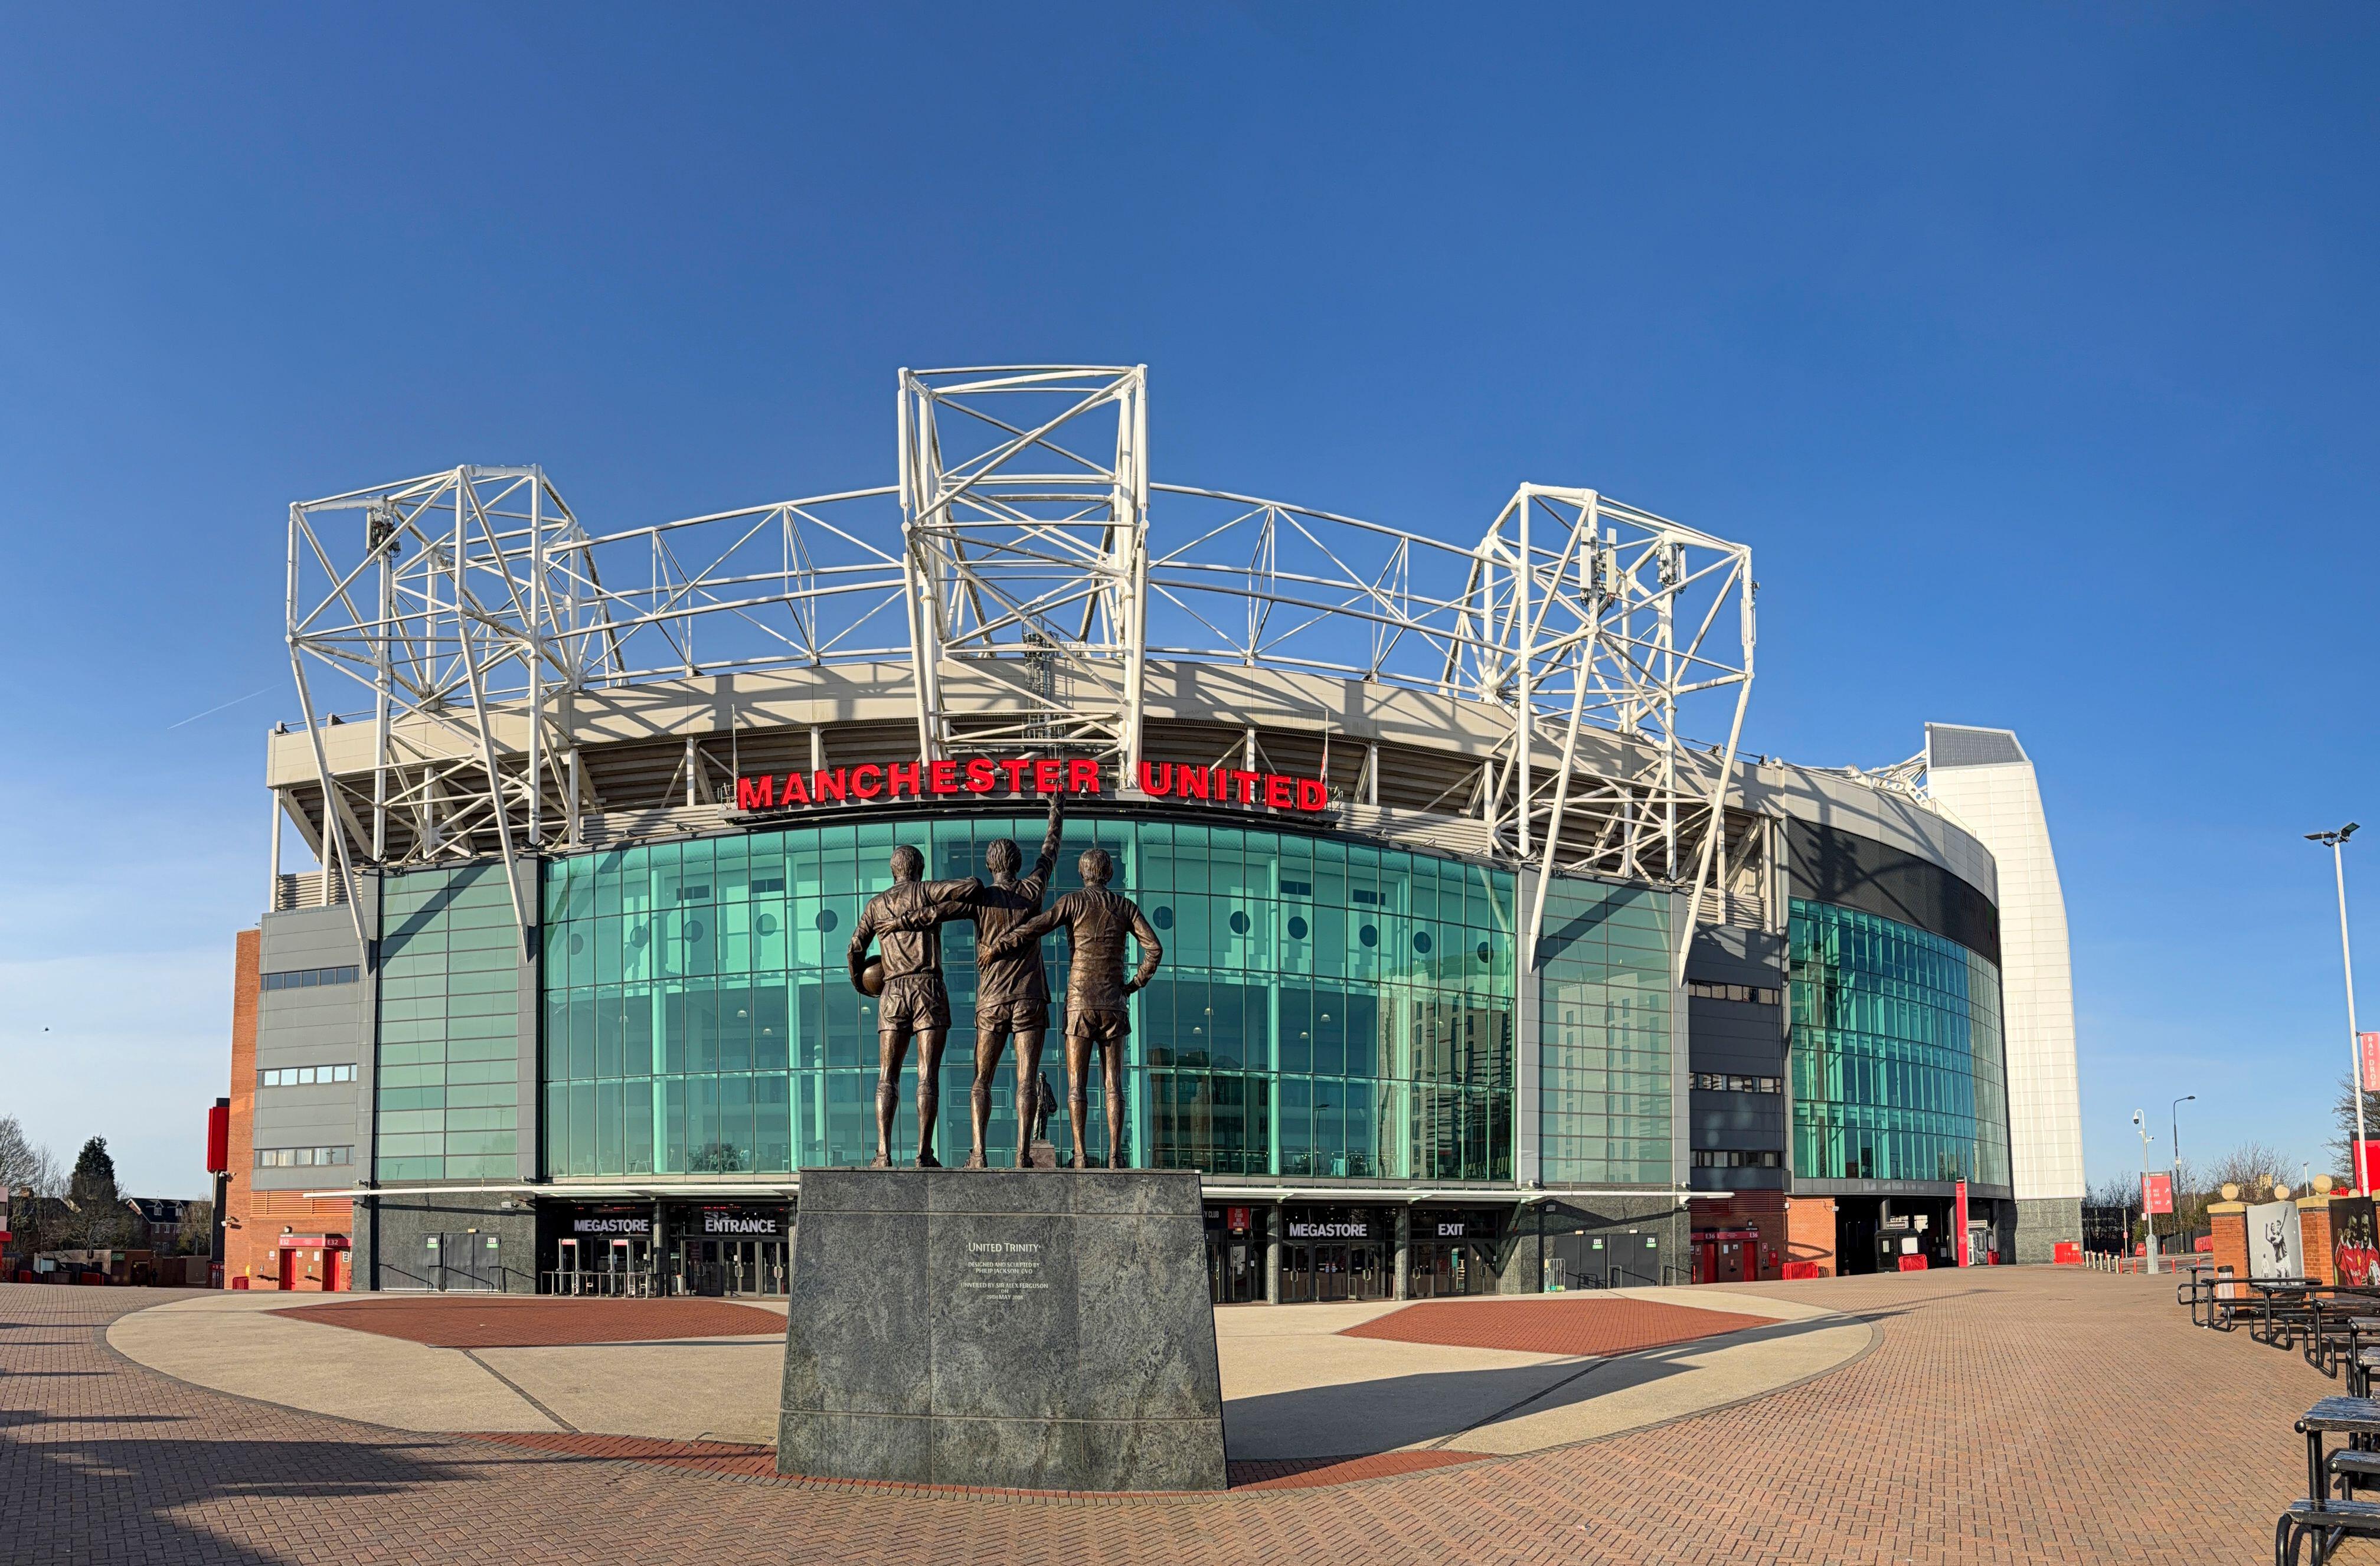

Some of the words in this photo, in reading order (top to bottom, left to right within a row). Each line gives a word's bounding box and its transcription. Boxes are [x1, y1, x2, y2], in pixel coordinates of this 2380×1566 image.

[738, 758, 1100, 810] MANCHESTER
[1140, 760, 1328, 812] UNITED
[574, 1219, 649, 1232] MEGASTORE
[705, 1219, 777, 1232] ENTRANCE
[1289, 1223, 1367, 1237] MEGASTORE
[1438, 1224, 1464, 1235] EXIT
